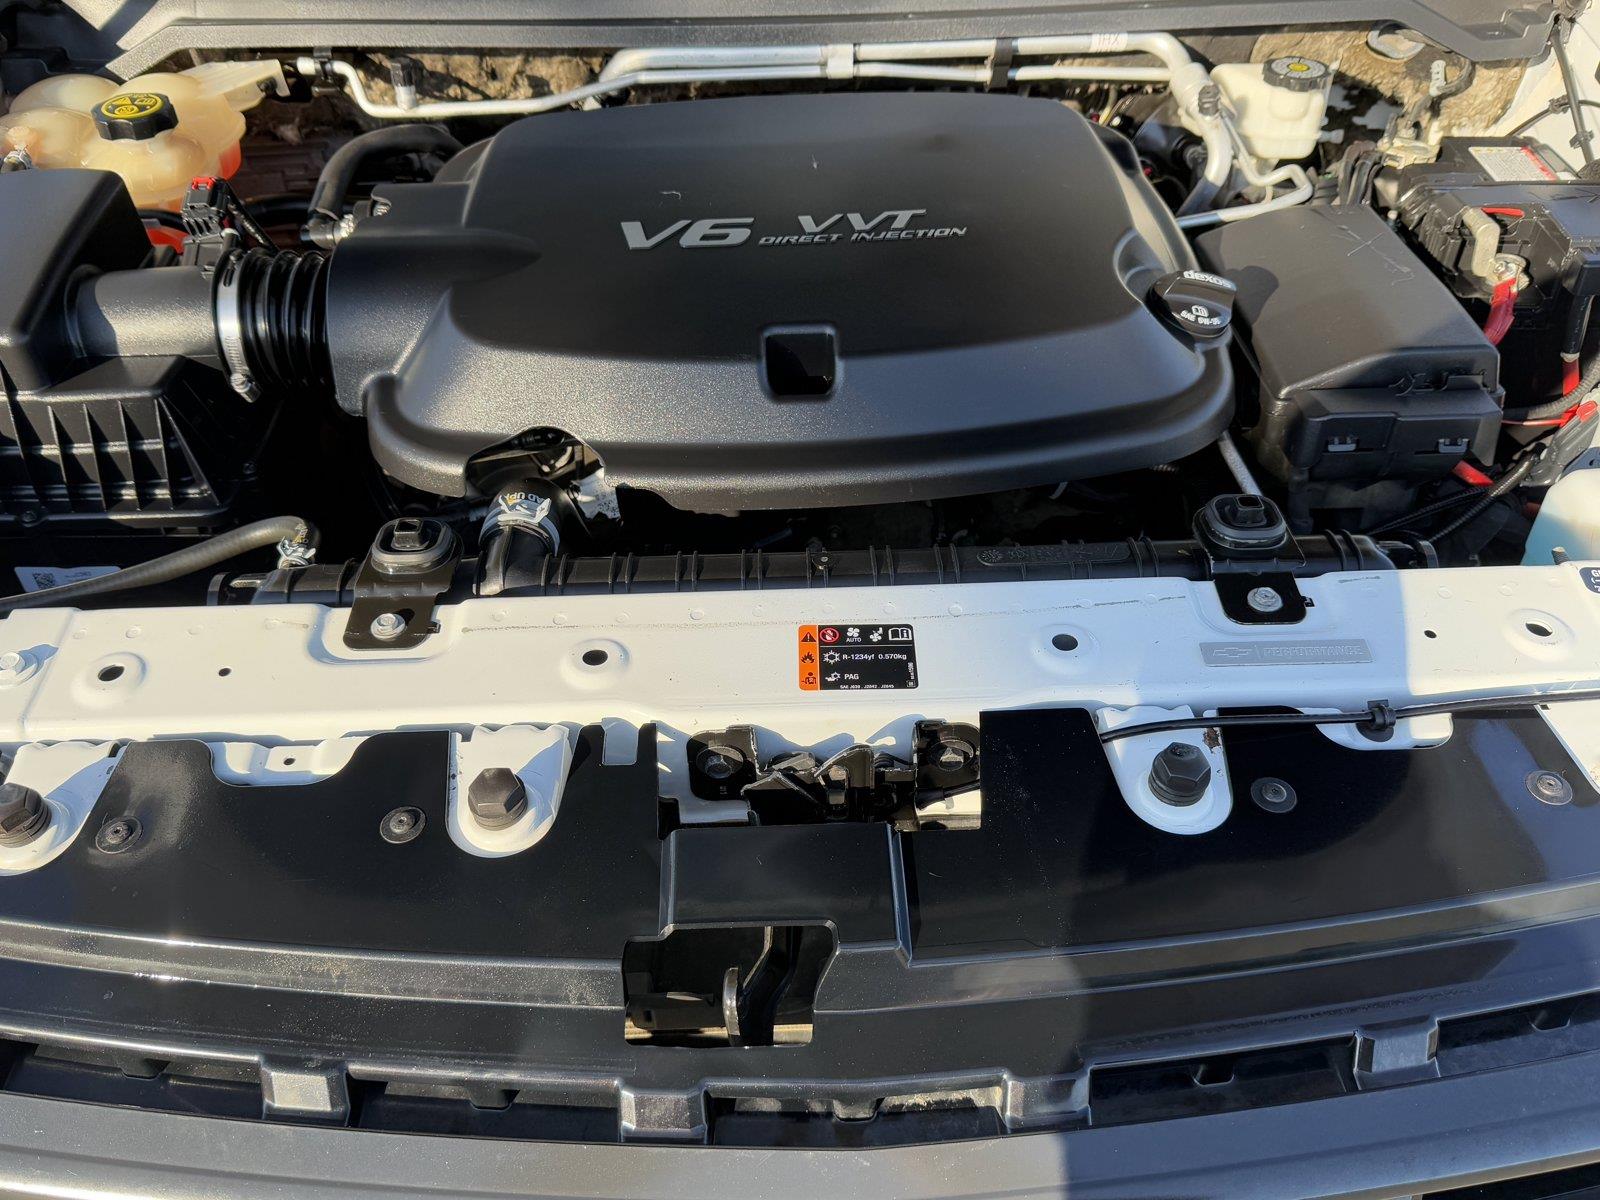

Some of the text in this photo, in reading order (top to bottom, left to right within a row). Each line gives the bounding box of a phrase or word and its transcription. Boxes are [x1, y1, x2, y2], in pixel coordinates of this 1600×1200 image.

[798, 209, 927, 233] VVT
[620, 217, 754, 250] V6
[758, 226, 968, 245] DIRECT INJECTION
[1183, 270, 1233, 289] dexos
[878, 653, 907, 661] 0.570kg
